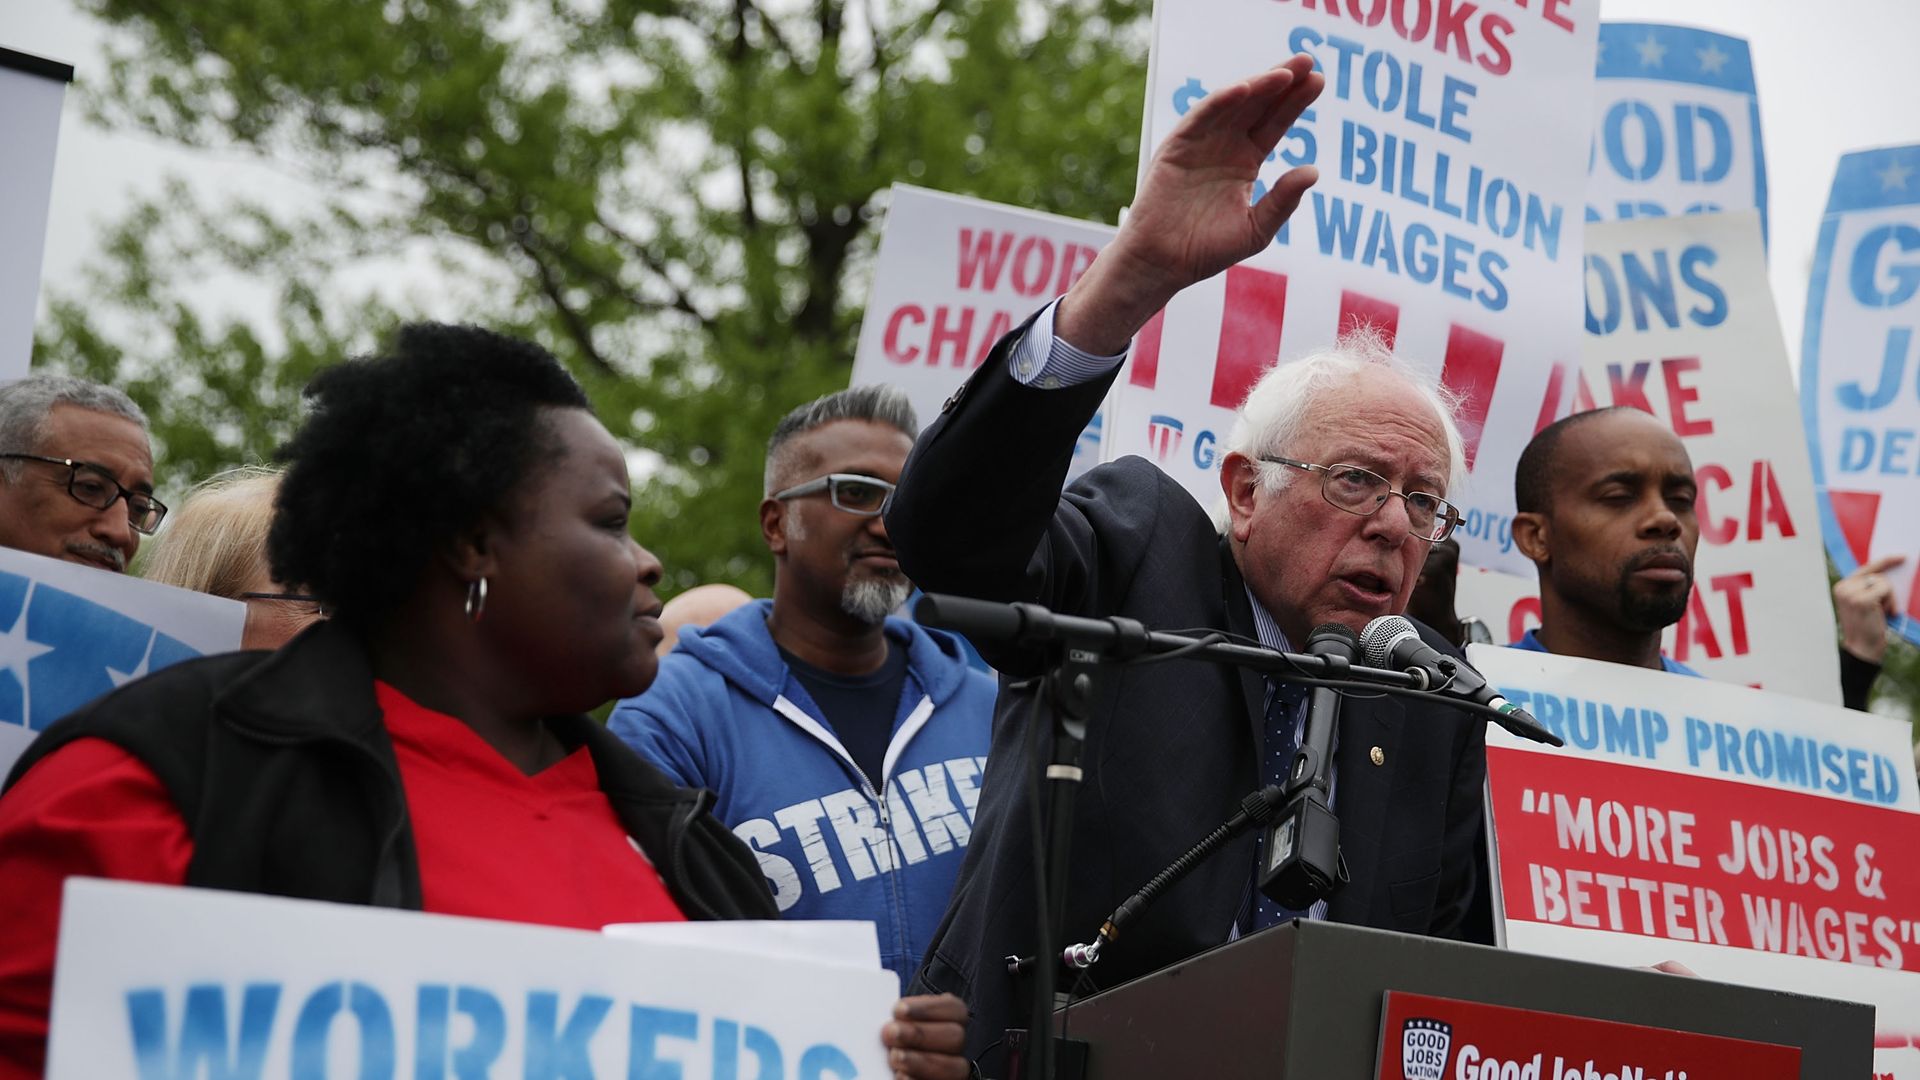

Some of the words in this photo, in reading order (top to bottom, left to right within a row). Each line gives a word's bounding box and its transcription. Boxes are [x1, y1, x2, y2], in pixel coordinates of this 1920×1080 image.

[1273, 0, 1515, 76] OOKS
[1288, 26, 1478, 144] STOLE
[1588, 100, 1733, 182] OD
[1341, 119, 1564, 262] BILLION
[1312, 191, 1509, 312] WAGES
[1585, 244, 1729, 335] ONS
[1834, 326, 1920, 412] J
[1838, 427, 1920, 477] DE
[1499, 687, 1669, 761] TRUMP
[1684, 716, 1899, 805] PROMISED
[732, 756, 988, 912] STRIKE
[1521, 788, 1700, 869] “MORE
[1718, 819, 1839, 891] JOBS
[1855, 843, 1886, 900] &
[1528, 863, 1729, 947] BETTER
[122, 981, 858, 1080] WORKE
[1406, 1031, 1446, 1051] GOOD
[1406, 1049, 1442, 1067] JOBS
[1406, 1065, 1440, 1080] NATION
[1455, 1044, 1542, 1080] Good
